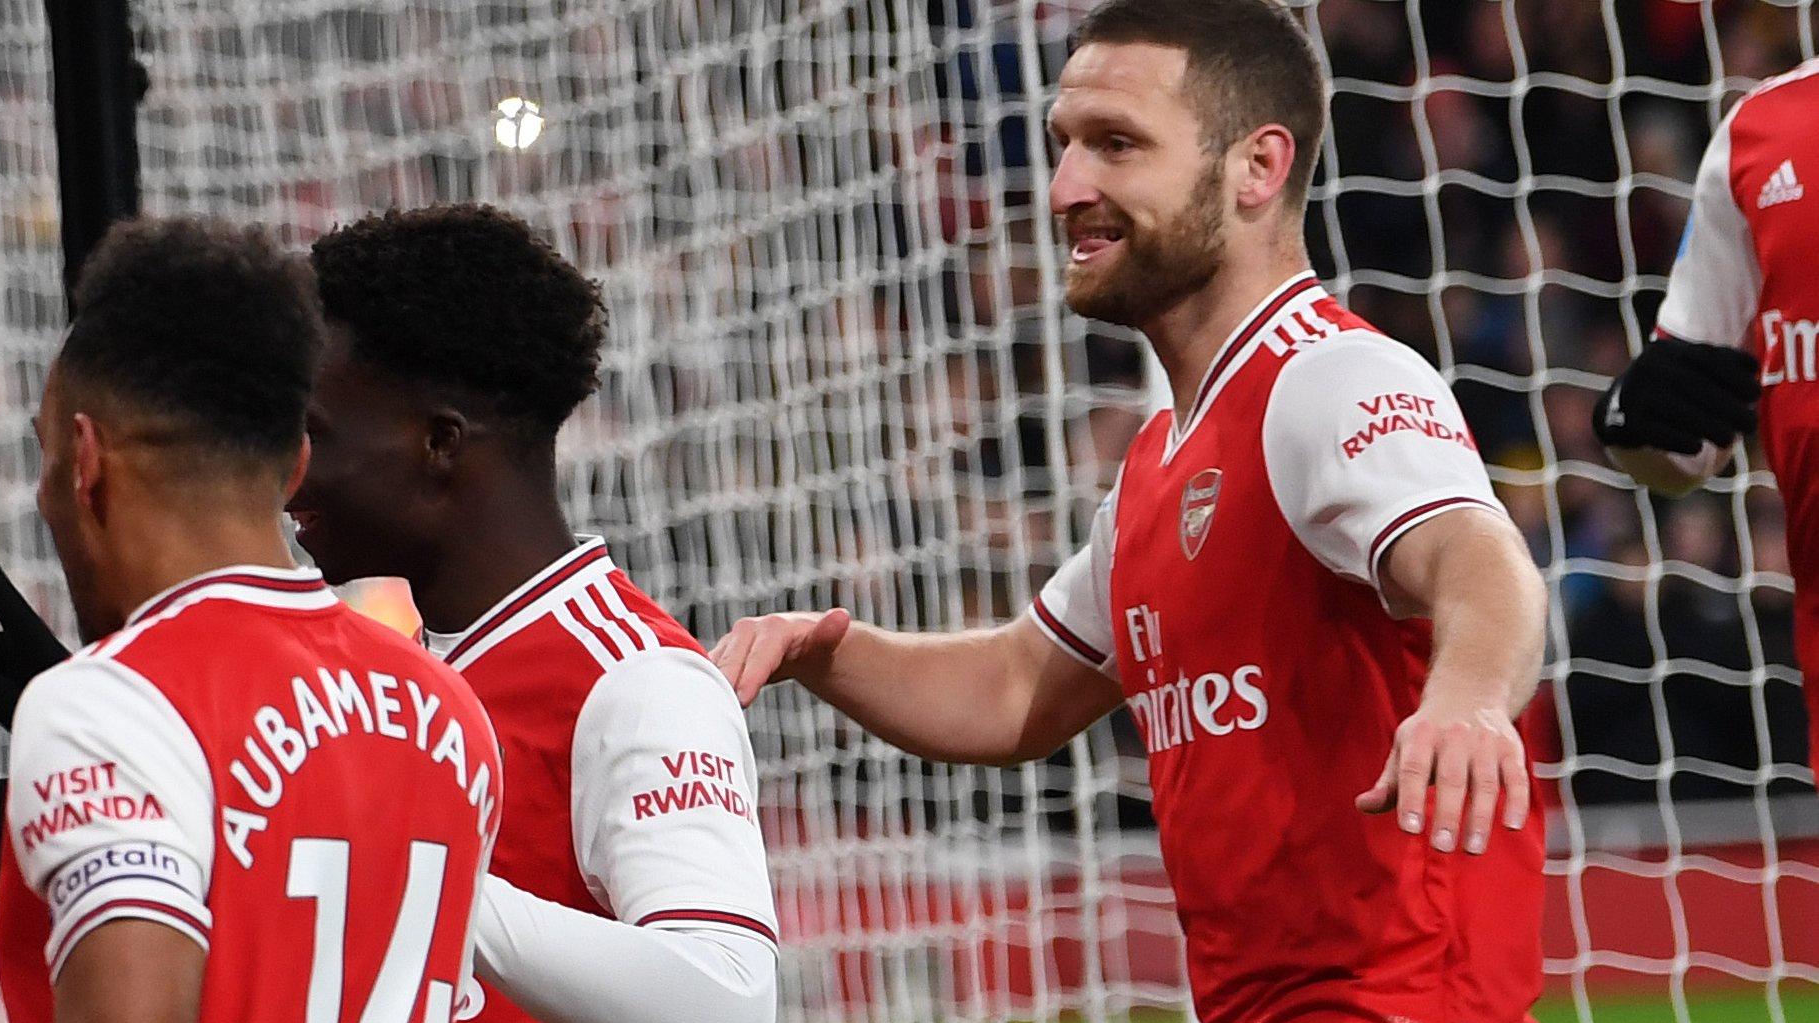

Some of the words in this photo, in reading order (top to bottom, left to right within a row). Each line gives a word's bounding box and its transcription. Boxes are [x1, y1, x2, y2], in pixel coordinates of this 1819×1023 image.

[1357, 392, 1435, 417] VISIT
[34, 762, 116, 803] VISIT
[222, 666, 494, 870] AUBAMEYAN
[661, 750, 735, 785] VISIT
[53, 840, 181, 906] Captain
